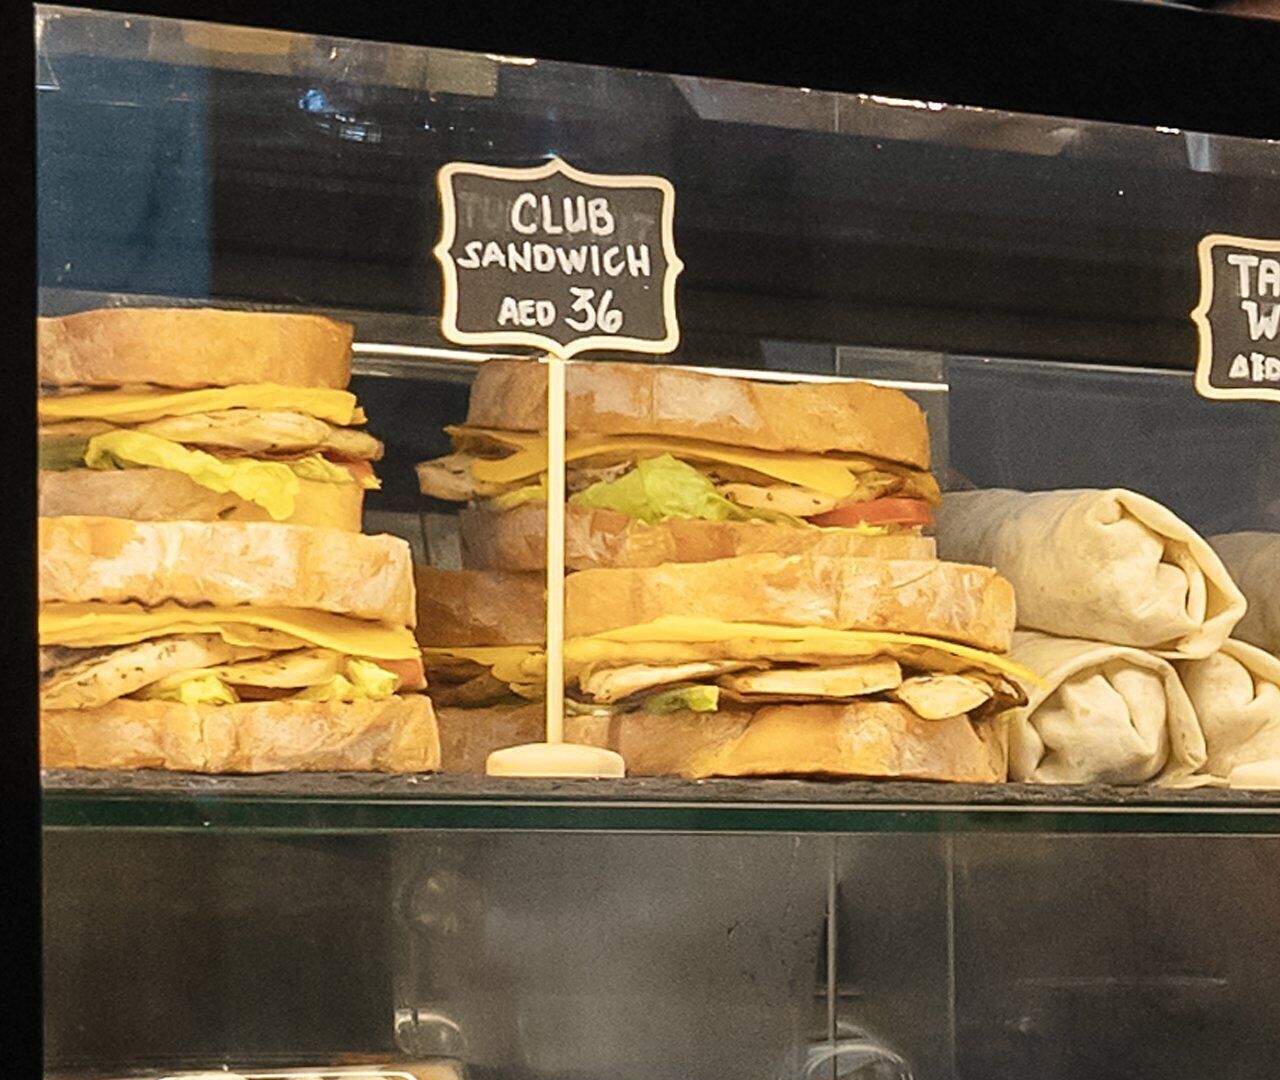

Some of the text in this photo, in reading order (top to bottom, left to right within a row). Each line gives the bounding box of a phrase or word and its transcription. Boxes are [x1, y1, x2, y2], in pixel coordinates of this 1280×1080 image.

[511, 192, 615, 236] CLUB
[457, 240, 650, 277] SANDWICH
[498, 287, 623, 333] AED 36
